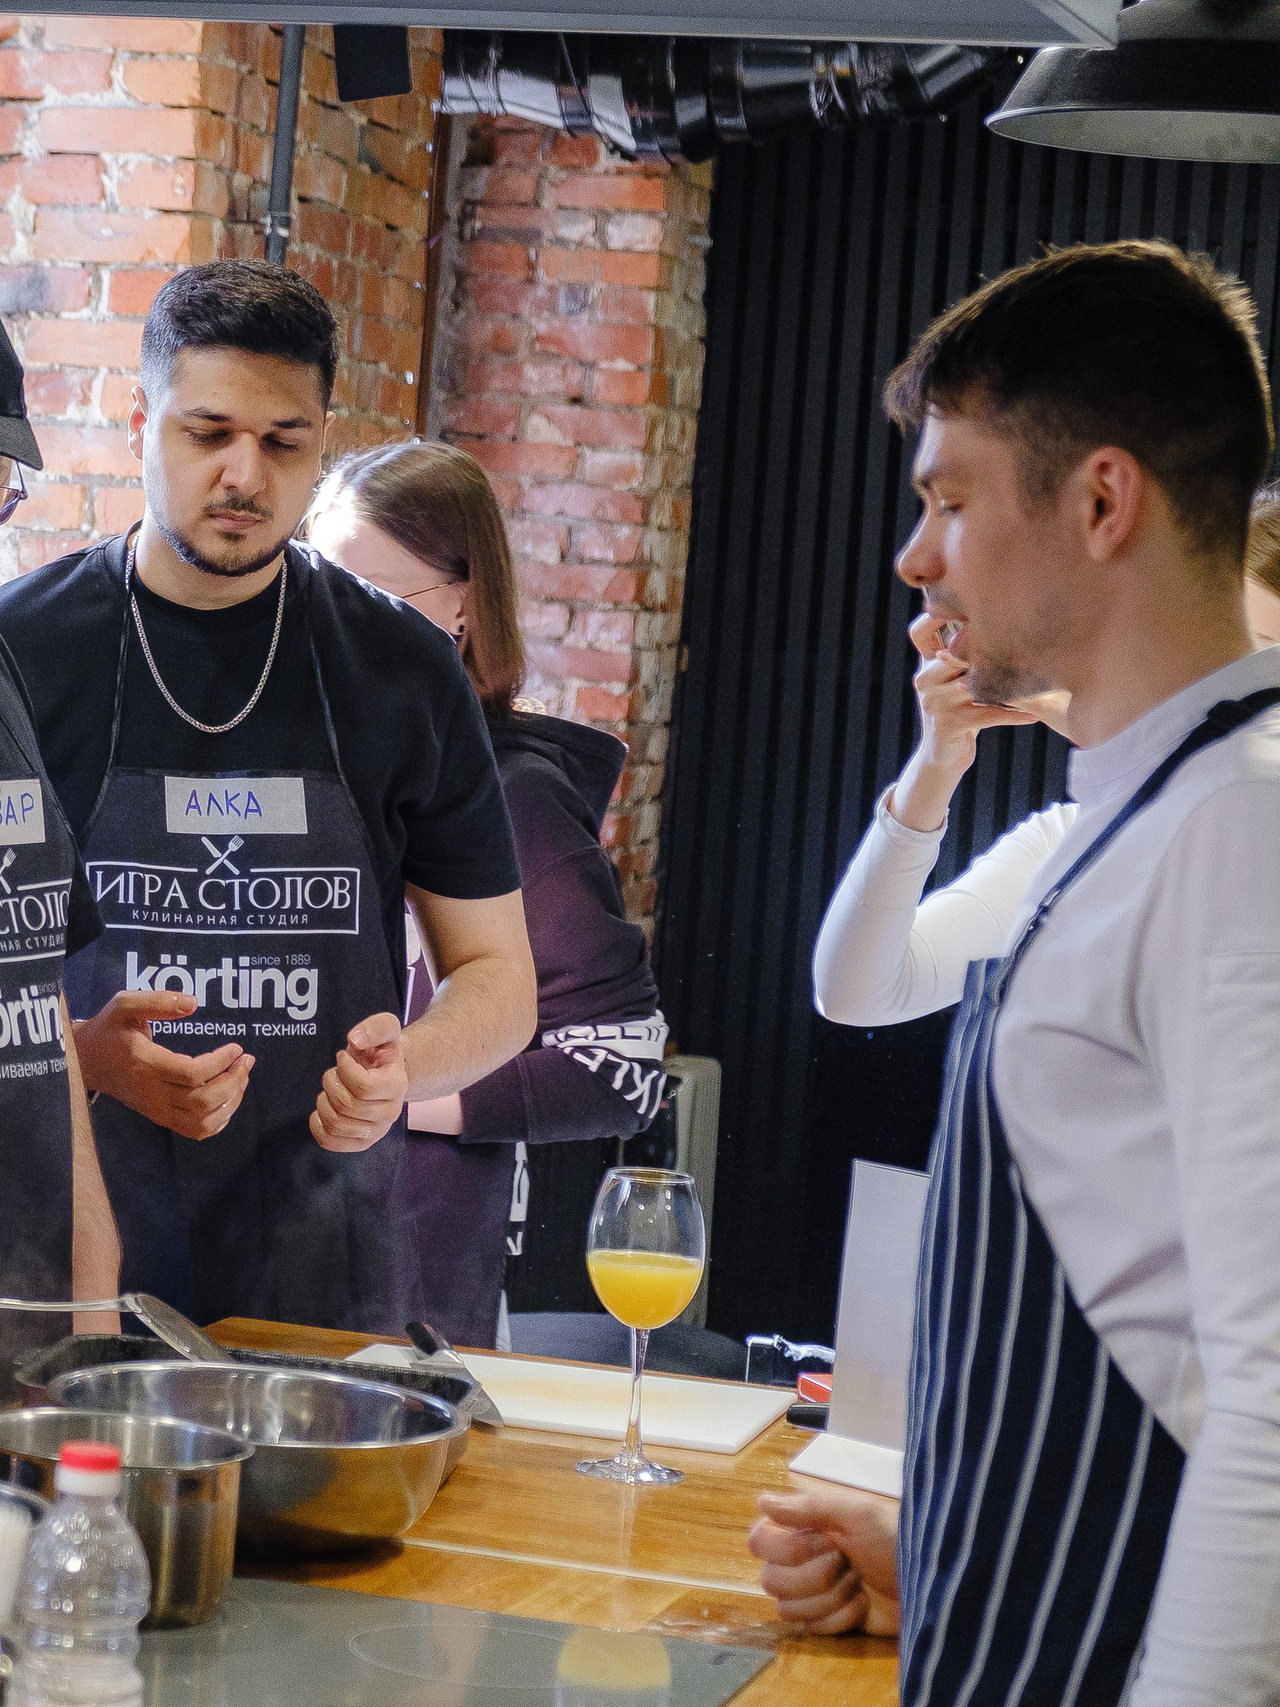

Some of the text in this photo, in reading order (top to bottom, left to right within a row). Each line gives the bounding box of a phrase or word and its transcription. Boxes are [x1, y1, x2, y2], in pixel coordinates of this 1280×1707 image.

[185, 789, 262, 819] АЛКА
[96, 869, 351, 910] ИГРА СТОЛОВ
[132, 909, 309, 926] КУЛИНАРНАЯ СТУДИЯ
[251, 955, 280, 966] since
[126, 951, 318, 1020] körting
[148, 1020, 317, 1037] раиваемая техника
